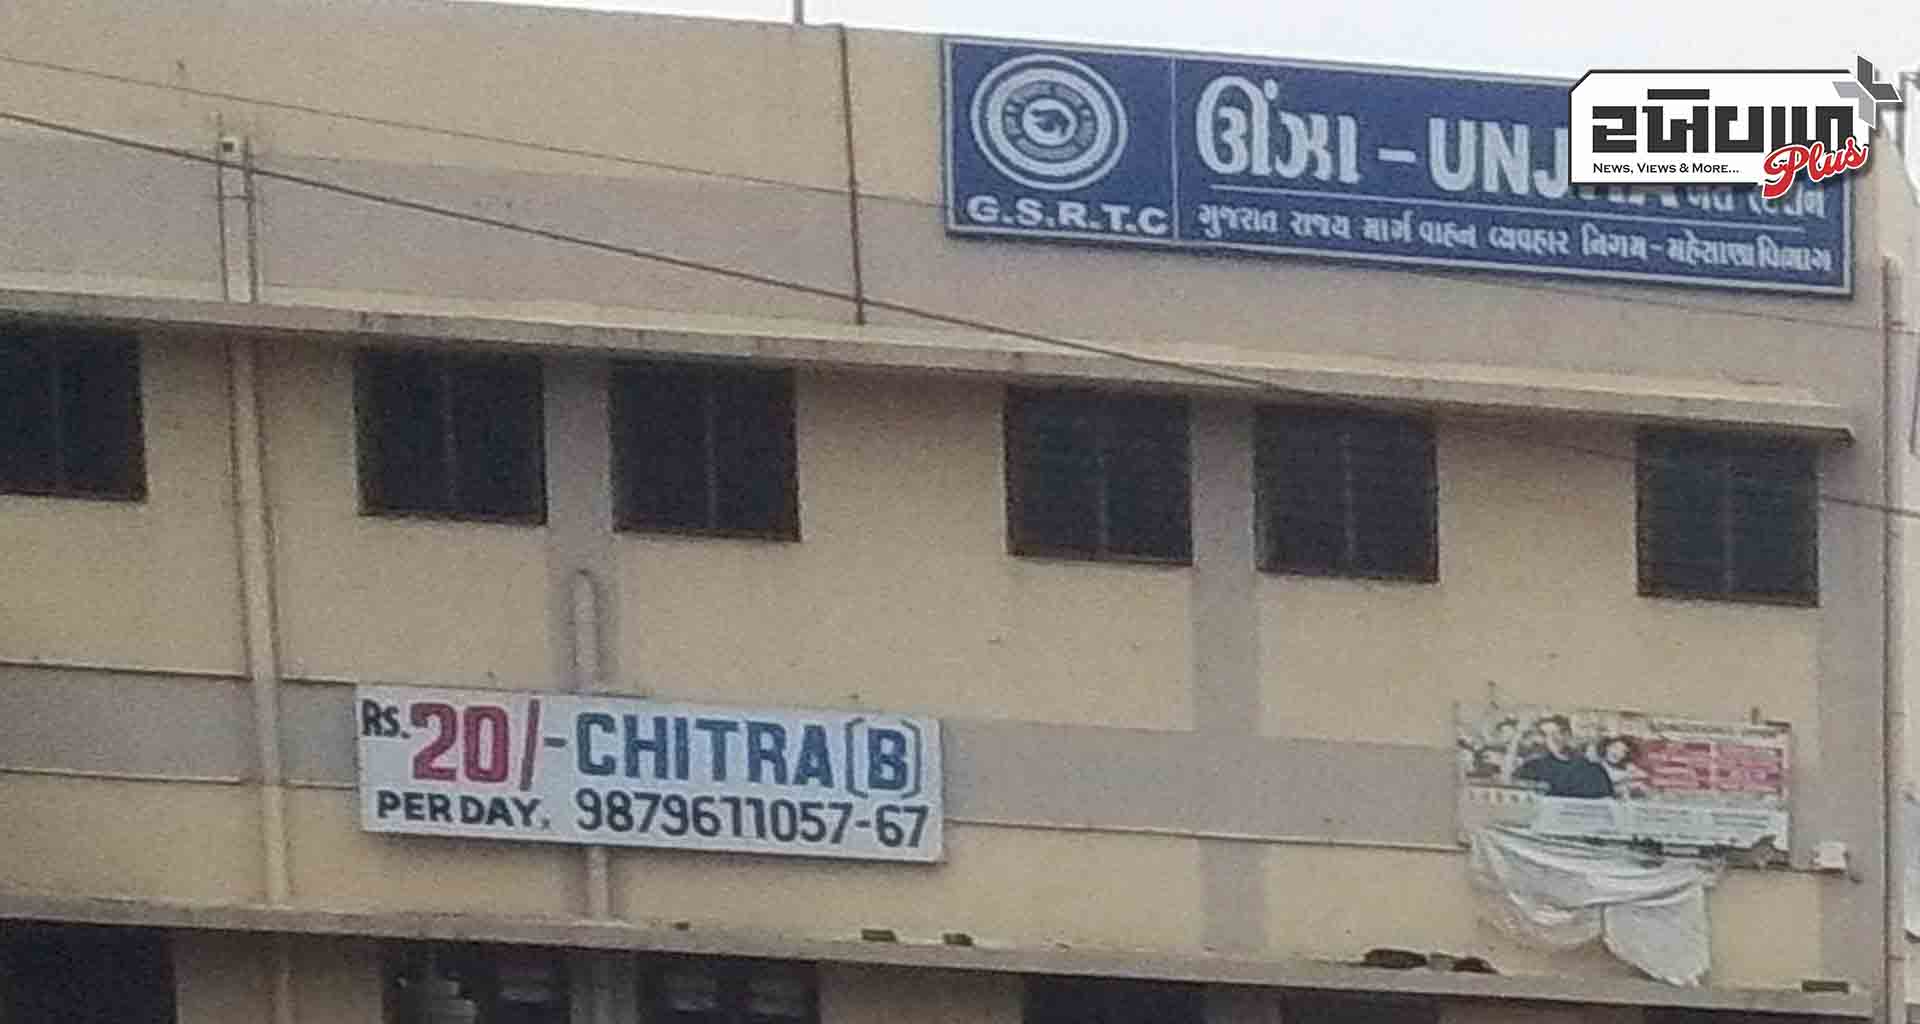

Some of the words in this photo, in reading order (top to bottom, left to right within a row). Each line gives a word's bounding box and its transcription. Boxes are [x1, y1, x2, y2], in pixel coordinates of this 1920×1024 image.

[1196, 75, 1361, 184] ઊંઝા
[1198, 203, 1279, 239] ગુજરાત
[1418, 219, 1478, 249] વાહન
[576, 712, 834, 789] CHITRA
[377, 790, 452, 823] PER
